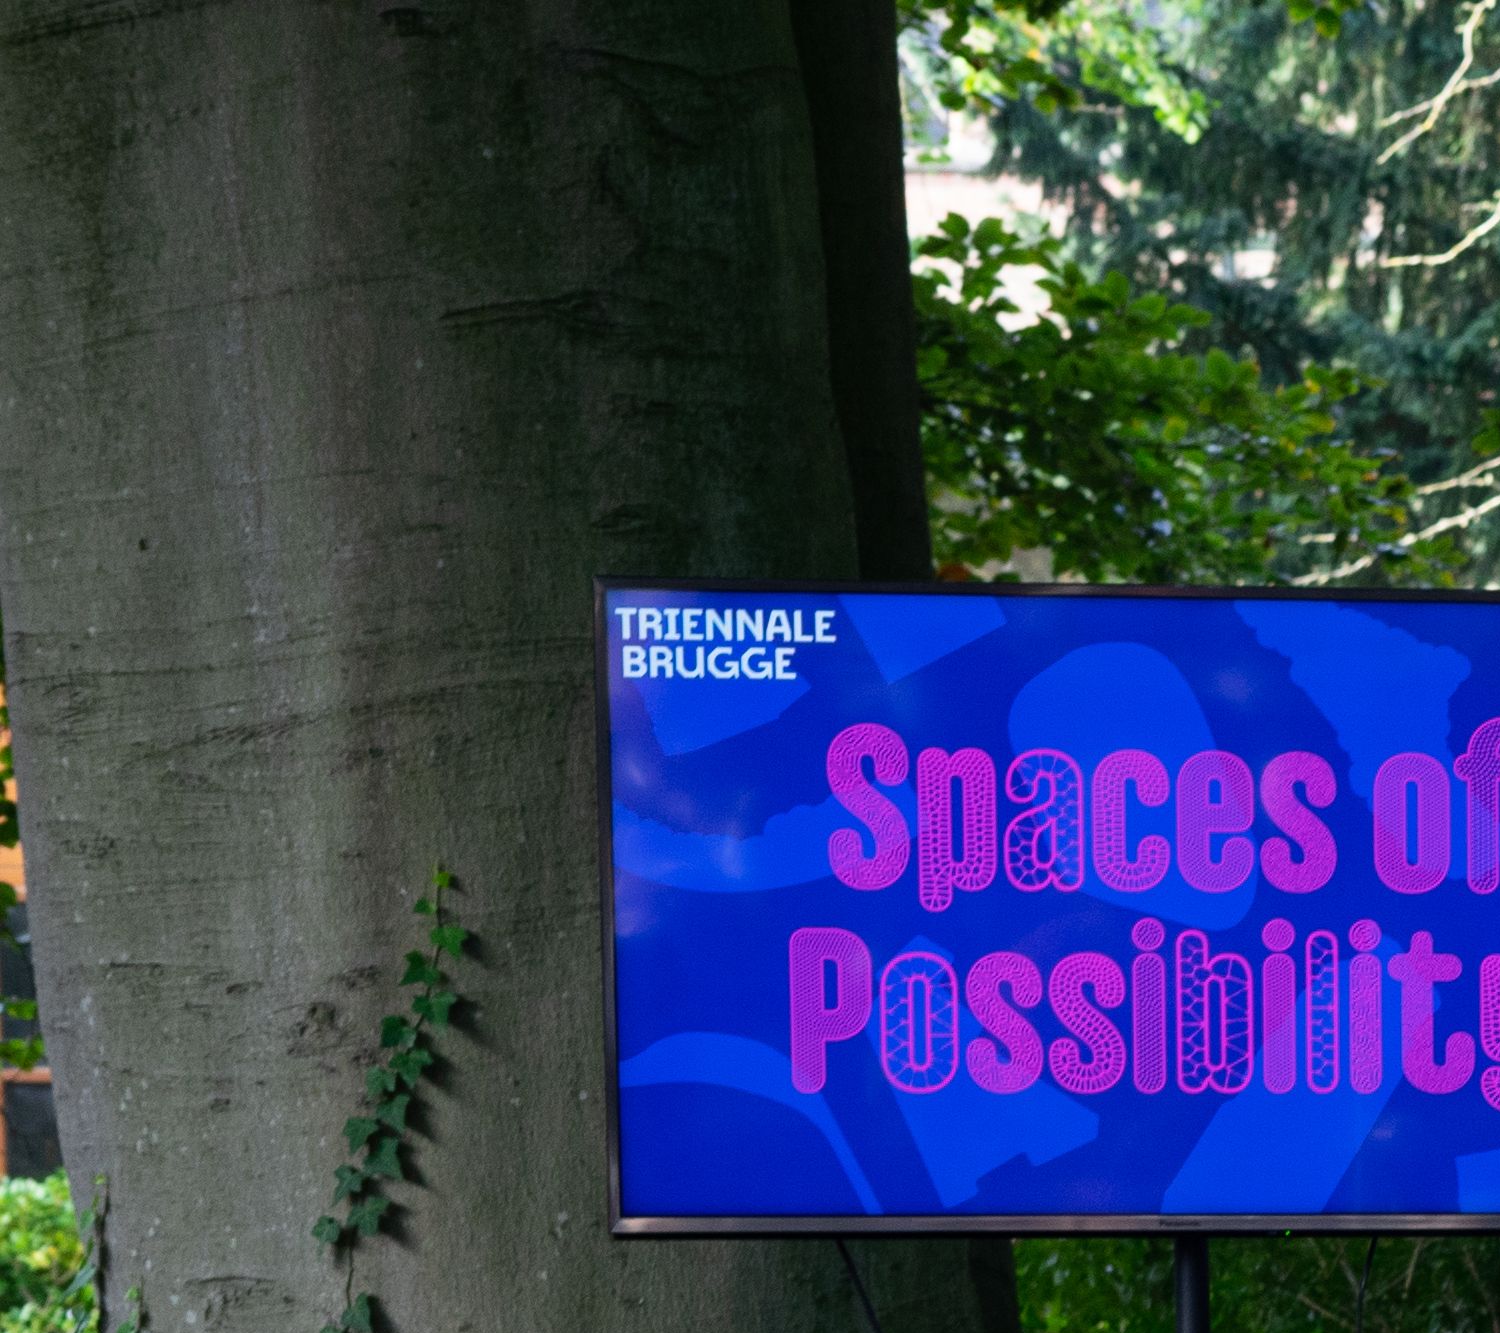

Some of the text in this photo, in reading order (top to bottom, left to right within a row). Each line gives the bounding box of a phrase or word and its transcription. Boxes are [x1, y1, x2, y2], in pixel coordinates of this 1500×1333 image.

[614, 607, 836, 642] TRIENNALE
[623, 645, 796, 679] BRUGGE
[826, 722, 1338, 913] Spaces
